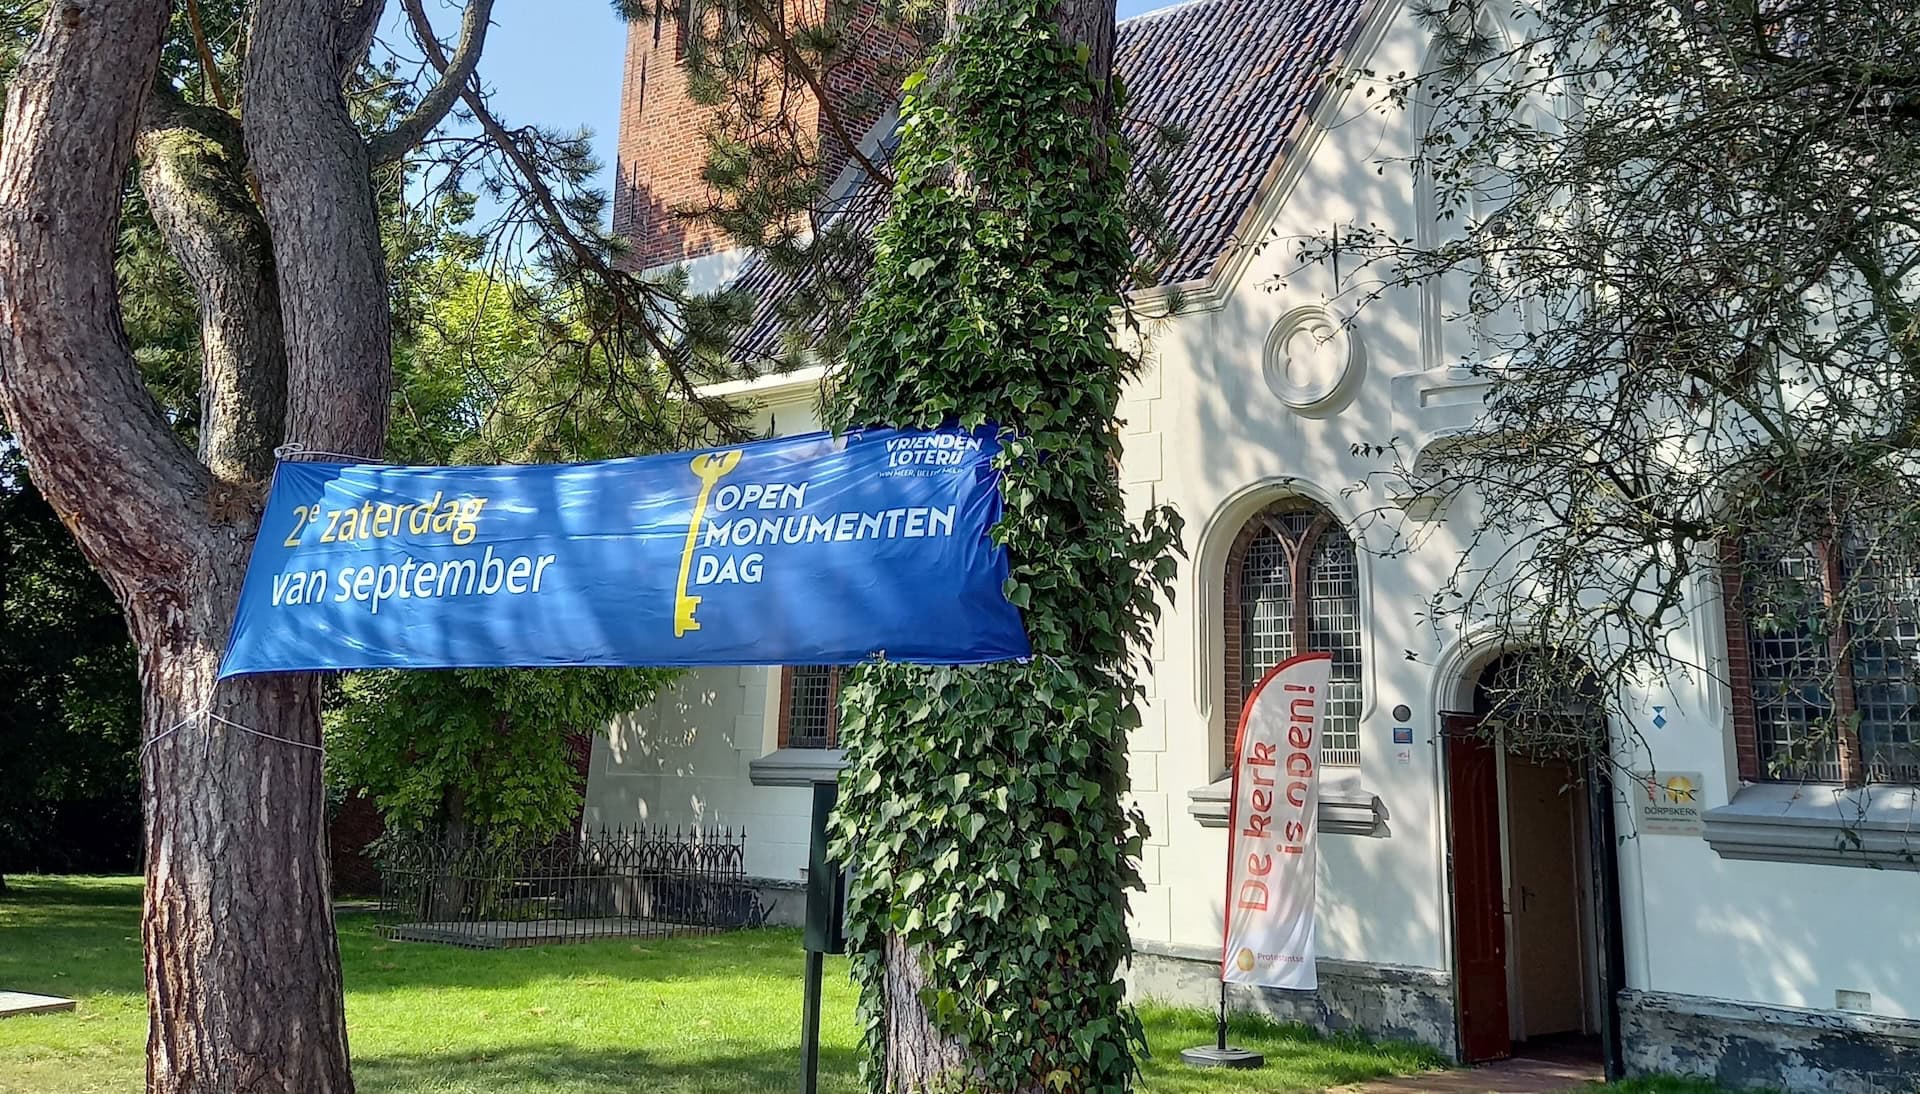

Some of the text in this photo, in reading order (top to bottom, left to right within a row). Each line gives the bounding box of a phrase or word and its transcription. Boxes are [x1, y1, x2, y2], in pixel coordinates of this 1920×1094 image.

[886, 434, 982, 452] VRIENDEN
[888, 450, 964, 468] LOTERIJ
[320, 491, 488, 545] zaterdag
[716, 483, 807, 512] OPEN
[703, 505, 955, 547] MONUMENTEN
[271, 546, 556, 614] van september
[696, 554, 764, 584] DAG
[1276, 684, 1315, 854] is open!
[1238, 742, 1276, 911] De kerk
